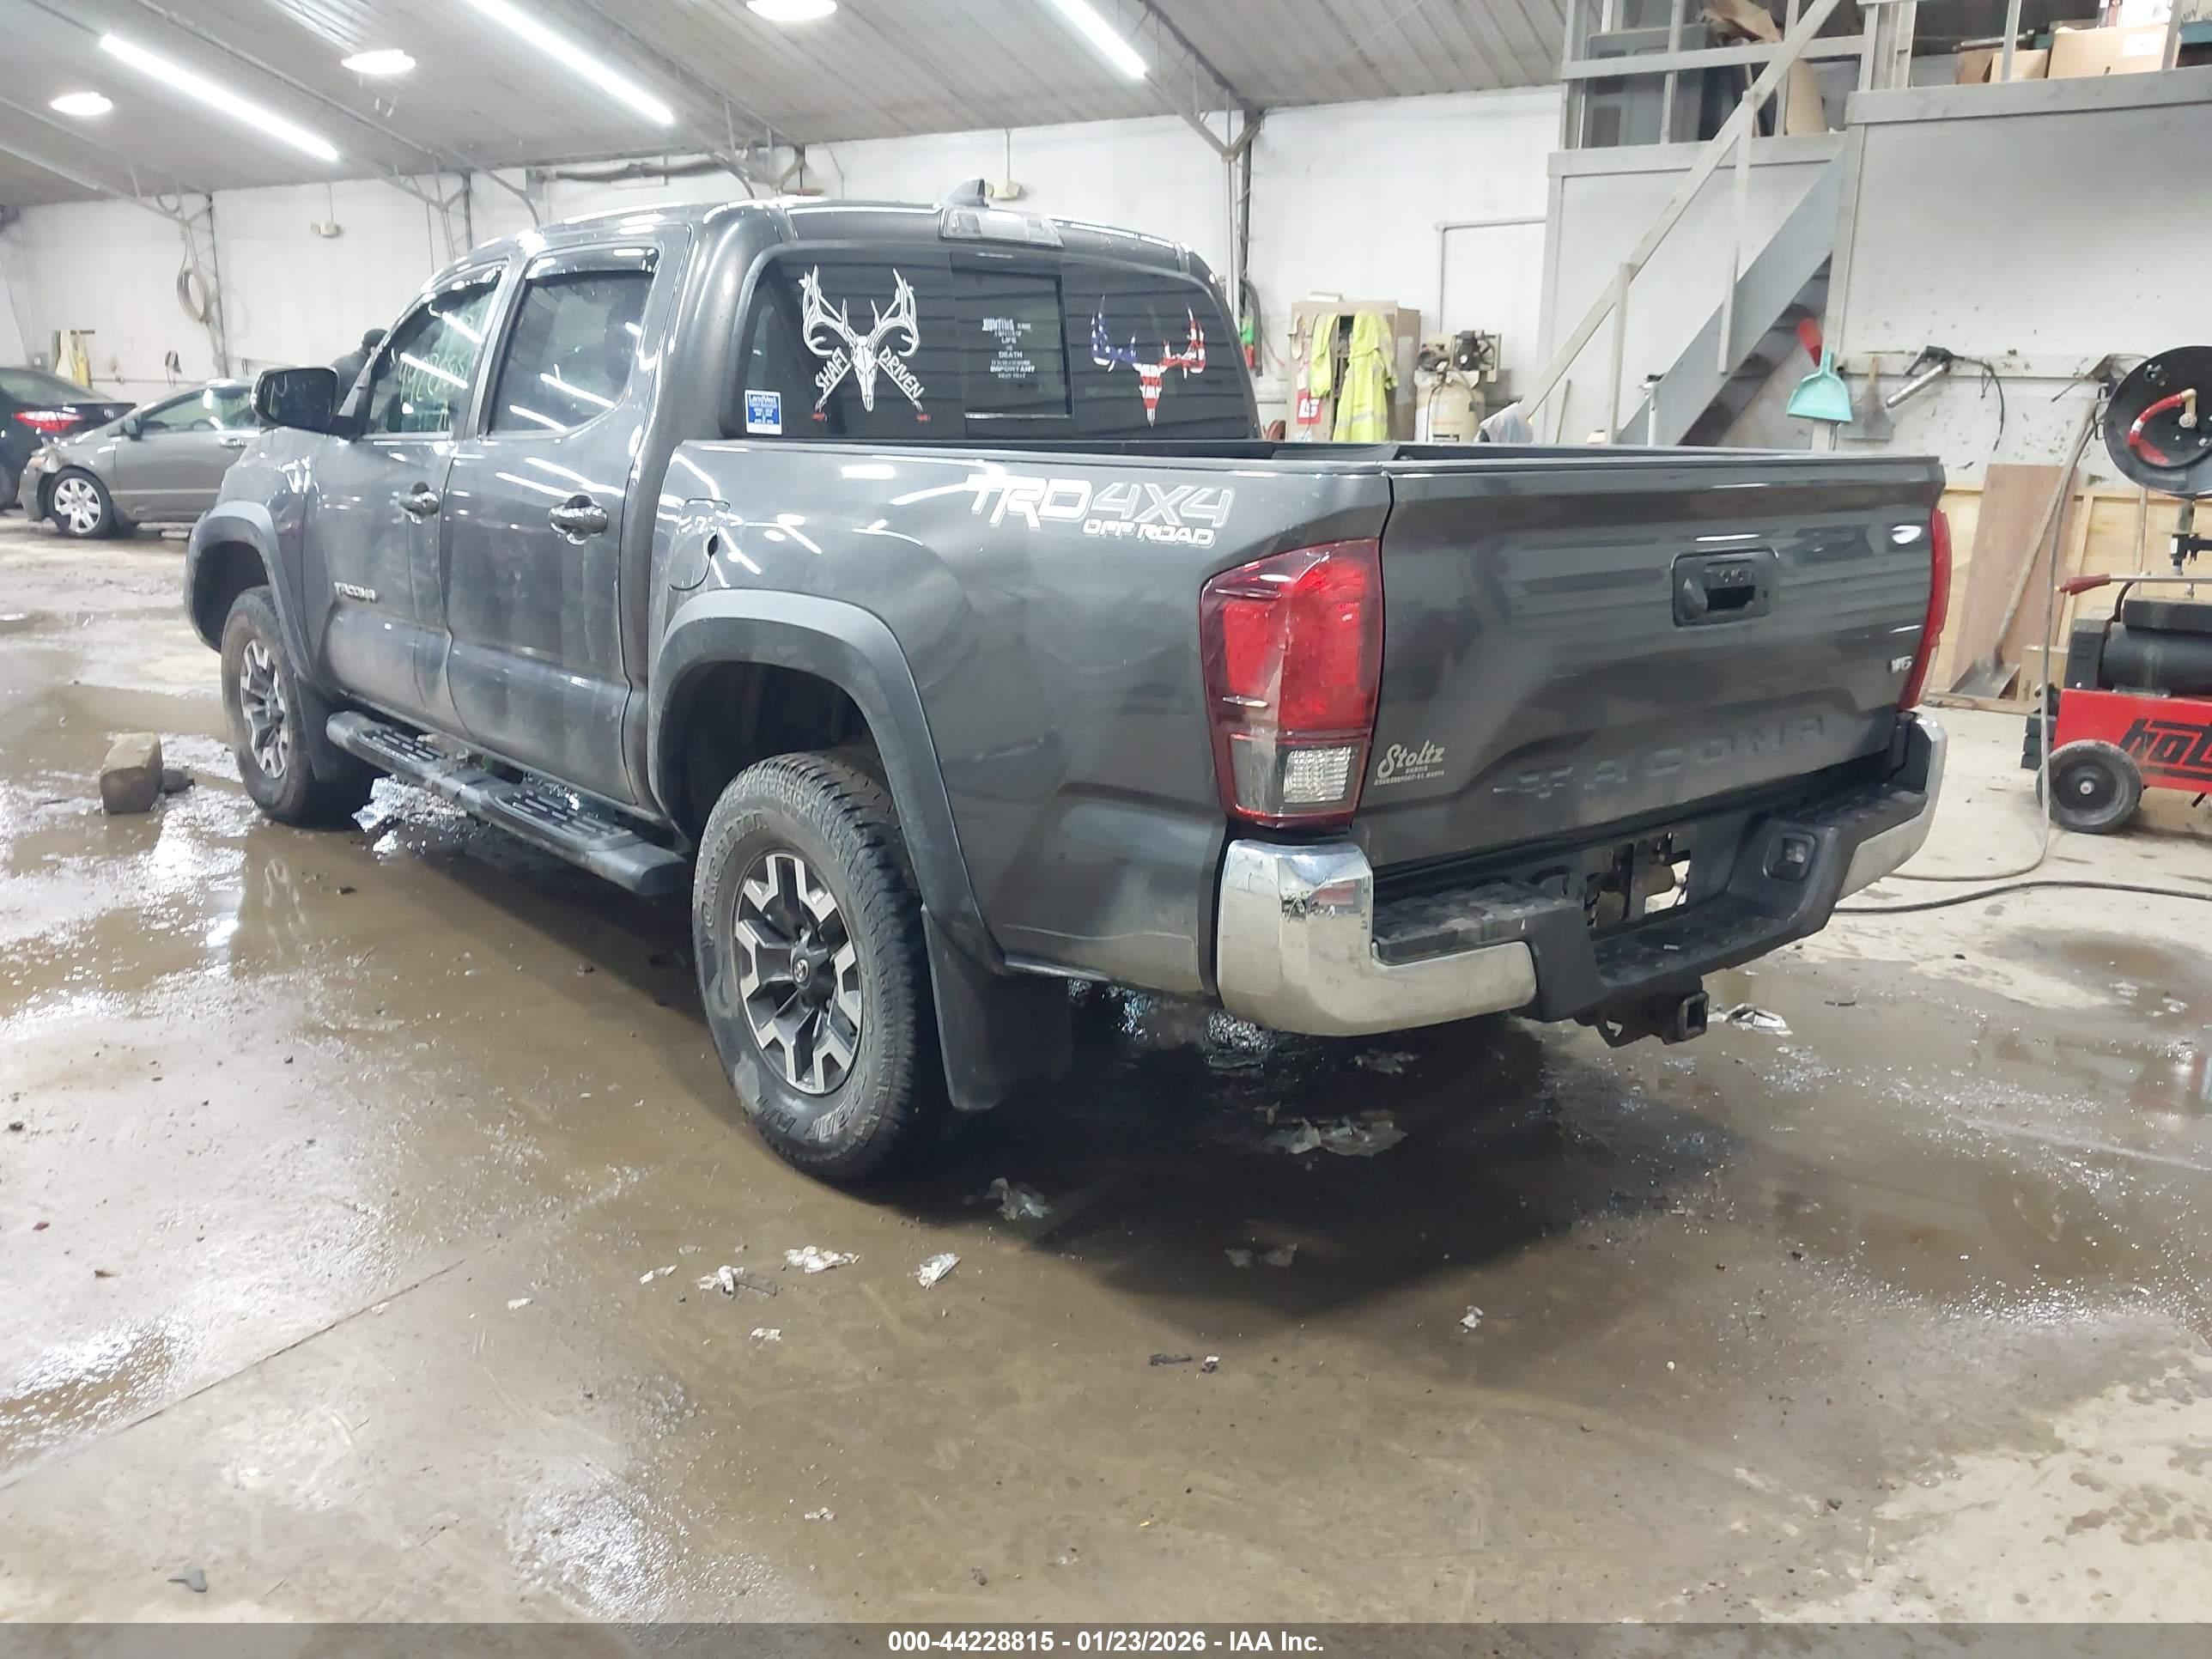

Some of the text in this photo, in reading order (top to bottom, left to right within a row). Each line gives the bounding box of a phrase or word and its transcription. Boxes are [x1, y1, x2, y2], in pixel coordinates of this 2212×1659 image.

[815, 344, 925, 398] SHAFT DRIVEN
[966, 473, 1237, 531] TRD 4X4
[1082, 519, 1217, 549] OFF ROAD
[1891, 654, 1913, 674] V6
[1376, 738, 1445, 779] Stoltz
